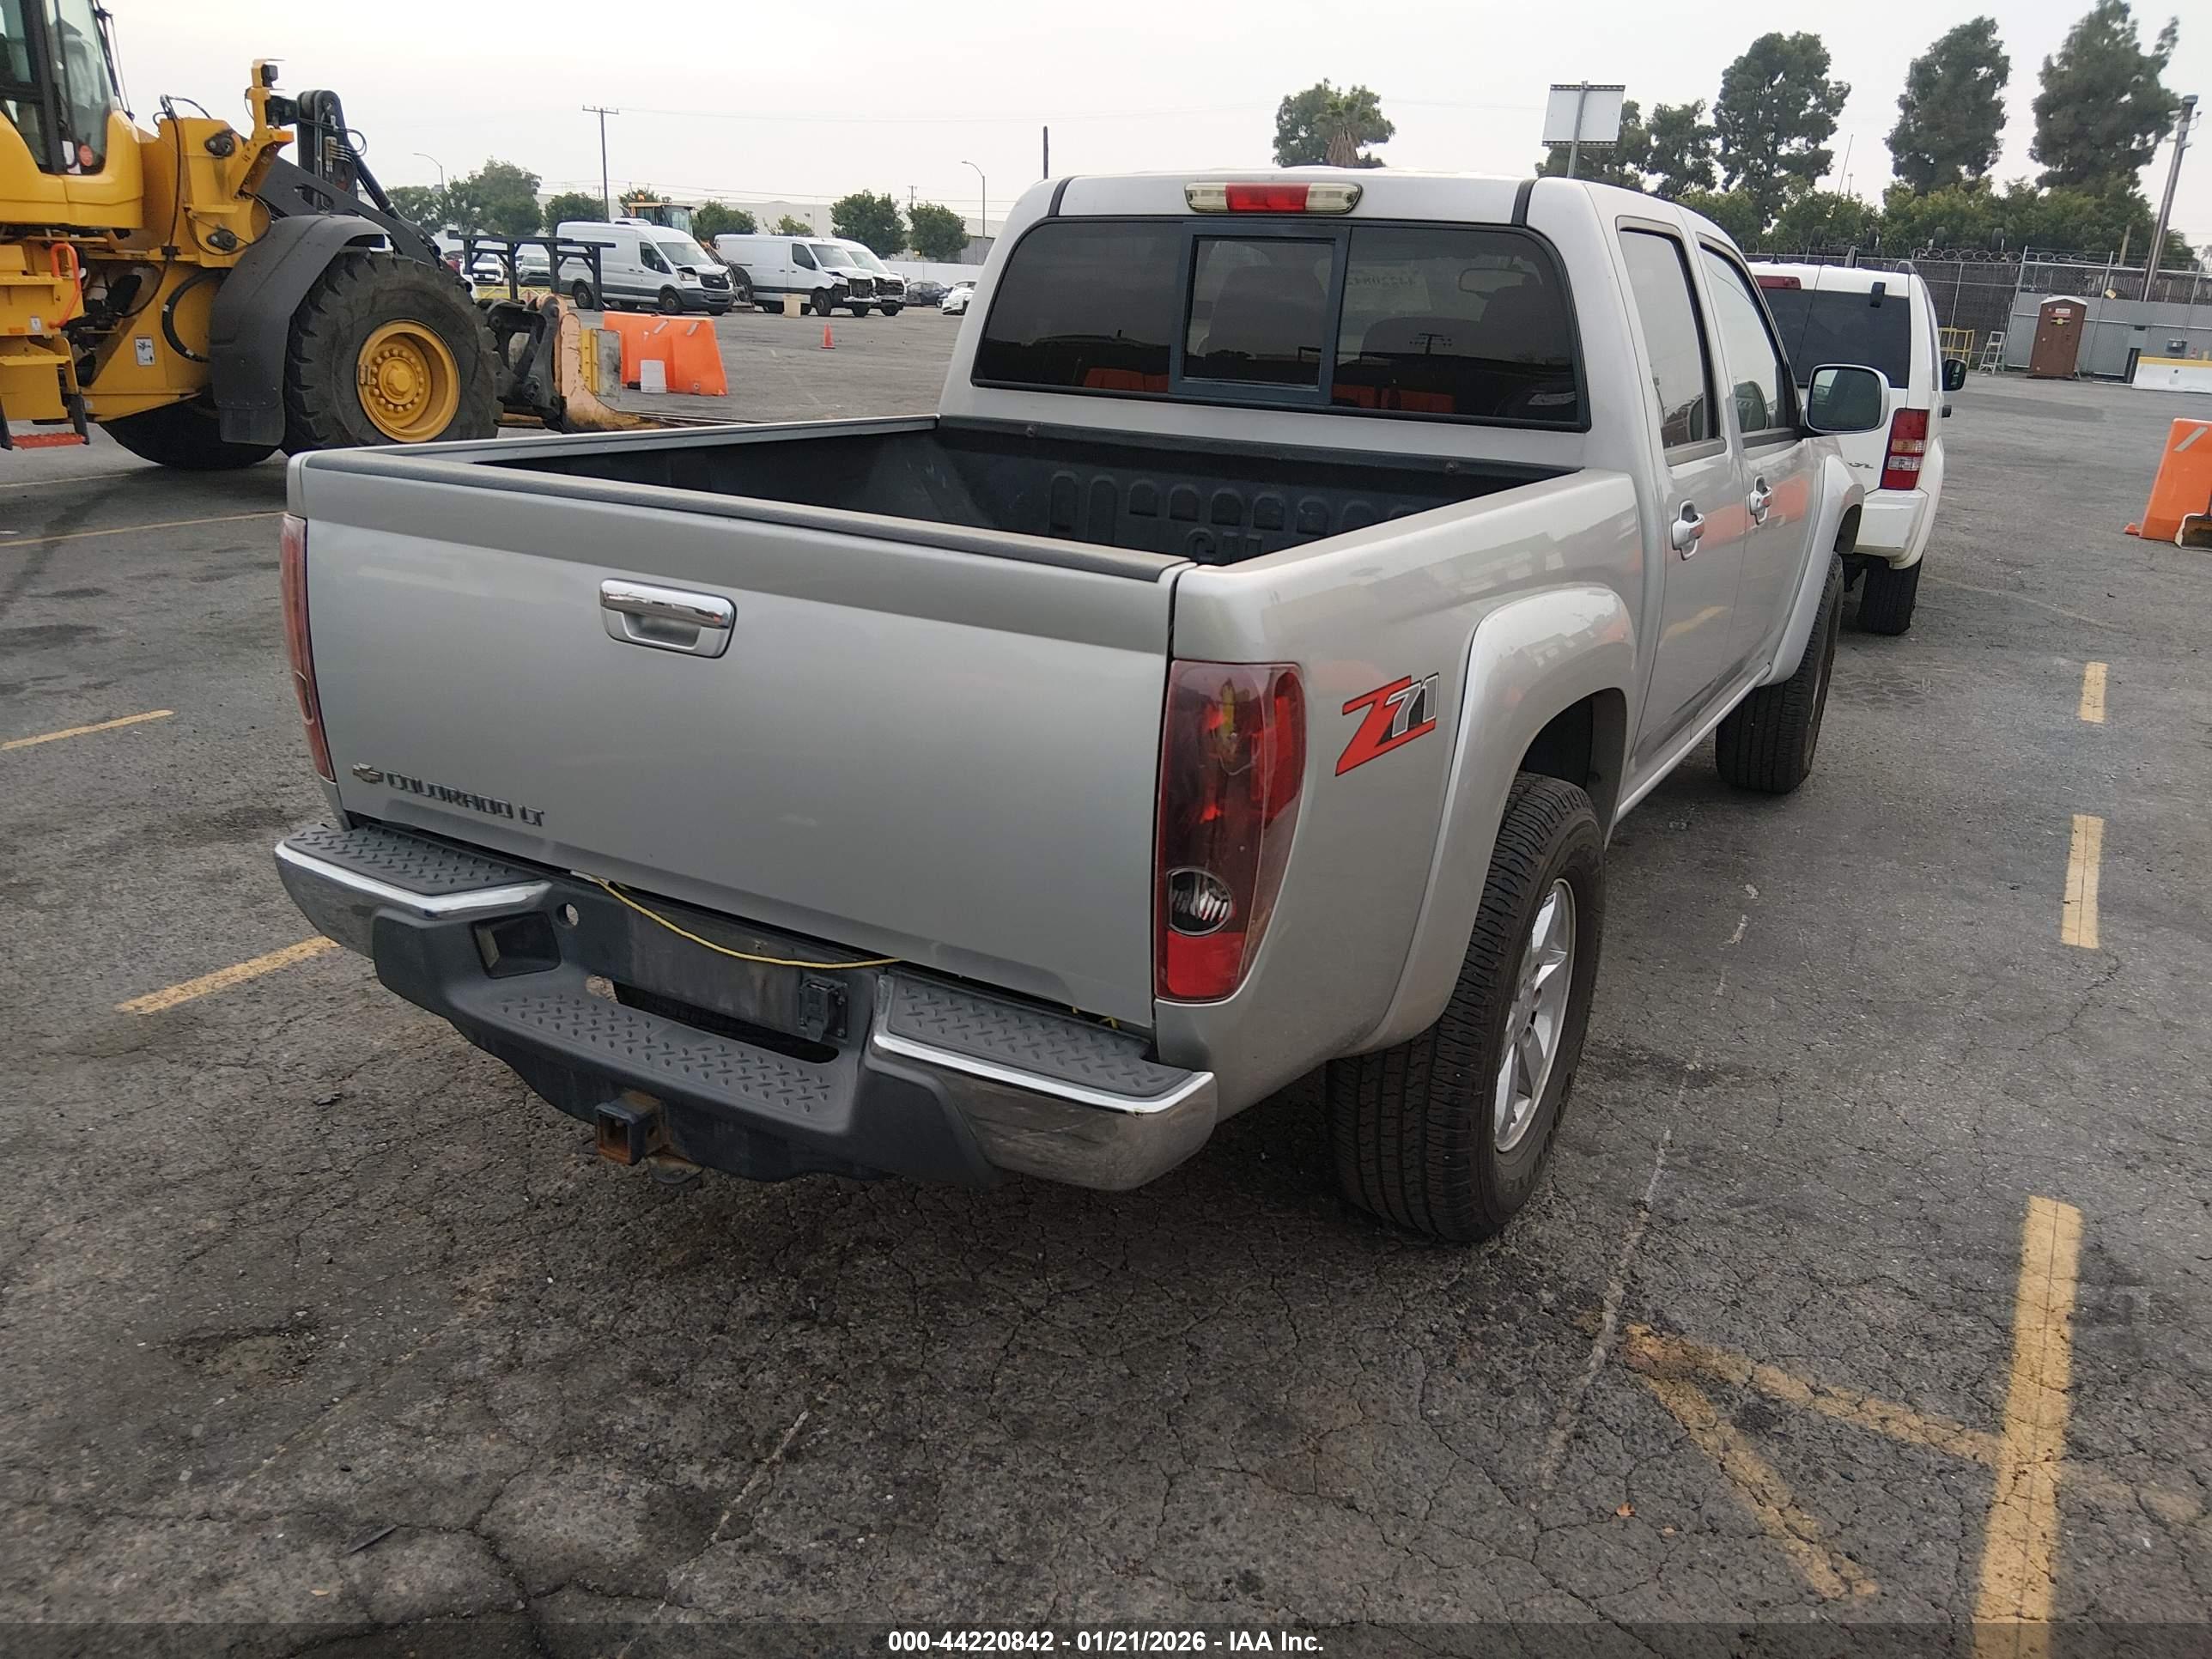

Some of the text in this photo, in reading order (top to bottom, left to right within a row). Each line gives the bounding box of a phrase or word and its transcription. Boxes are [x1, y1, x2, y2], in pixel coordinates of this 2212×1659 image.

[1335, 672, 1439, 777] Z71
[386, 770, 545, 827] COLORADO LT
